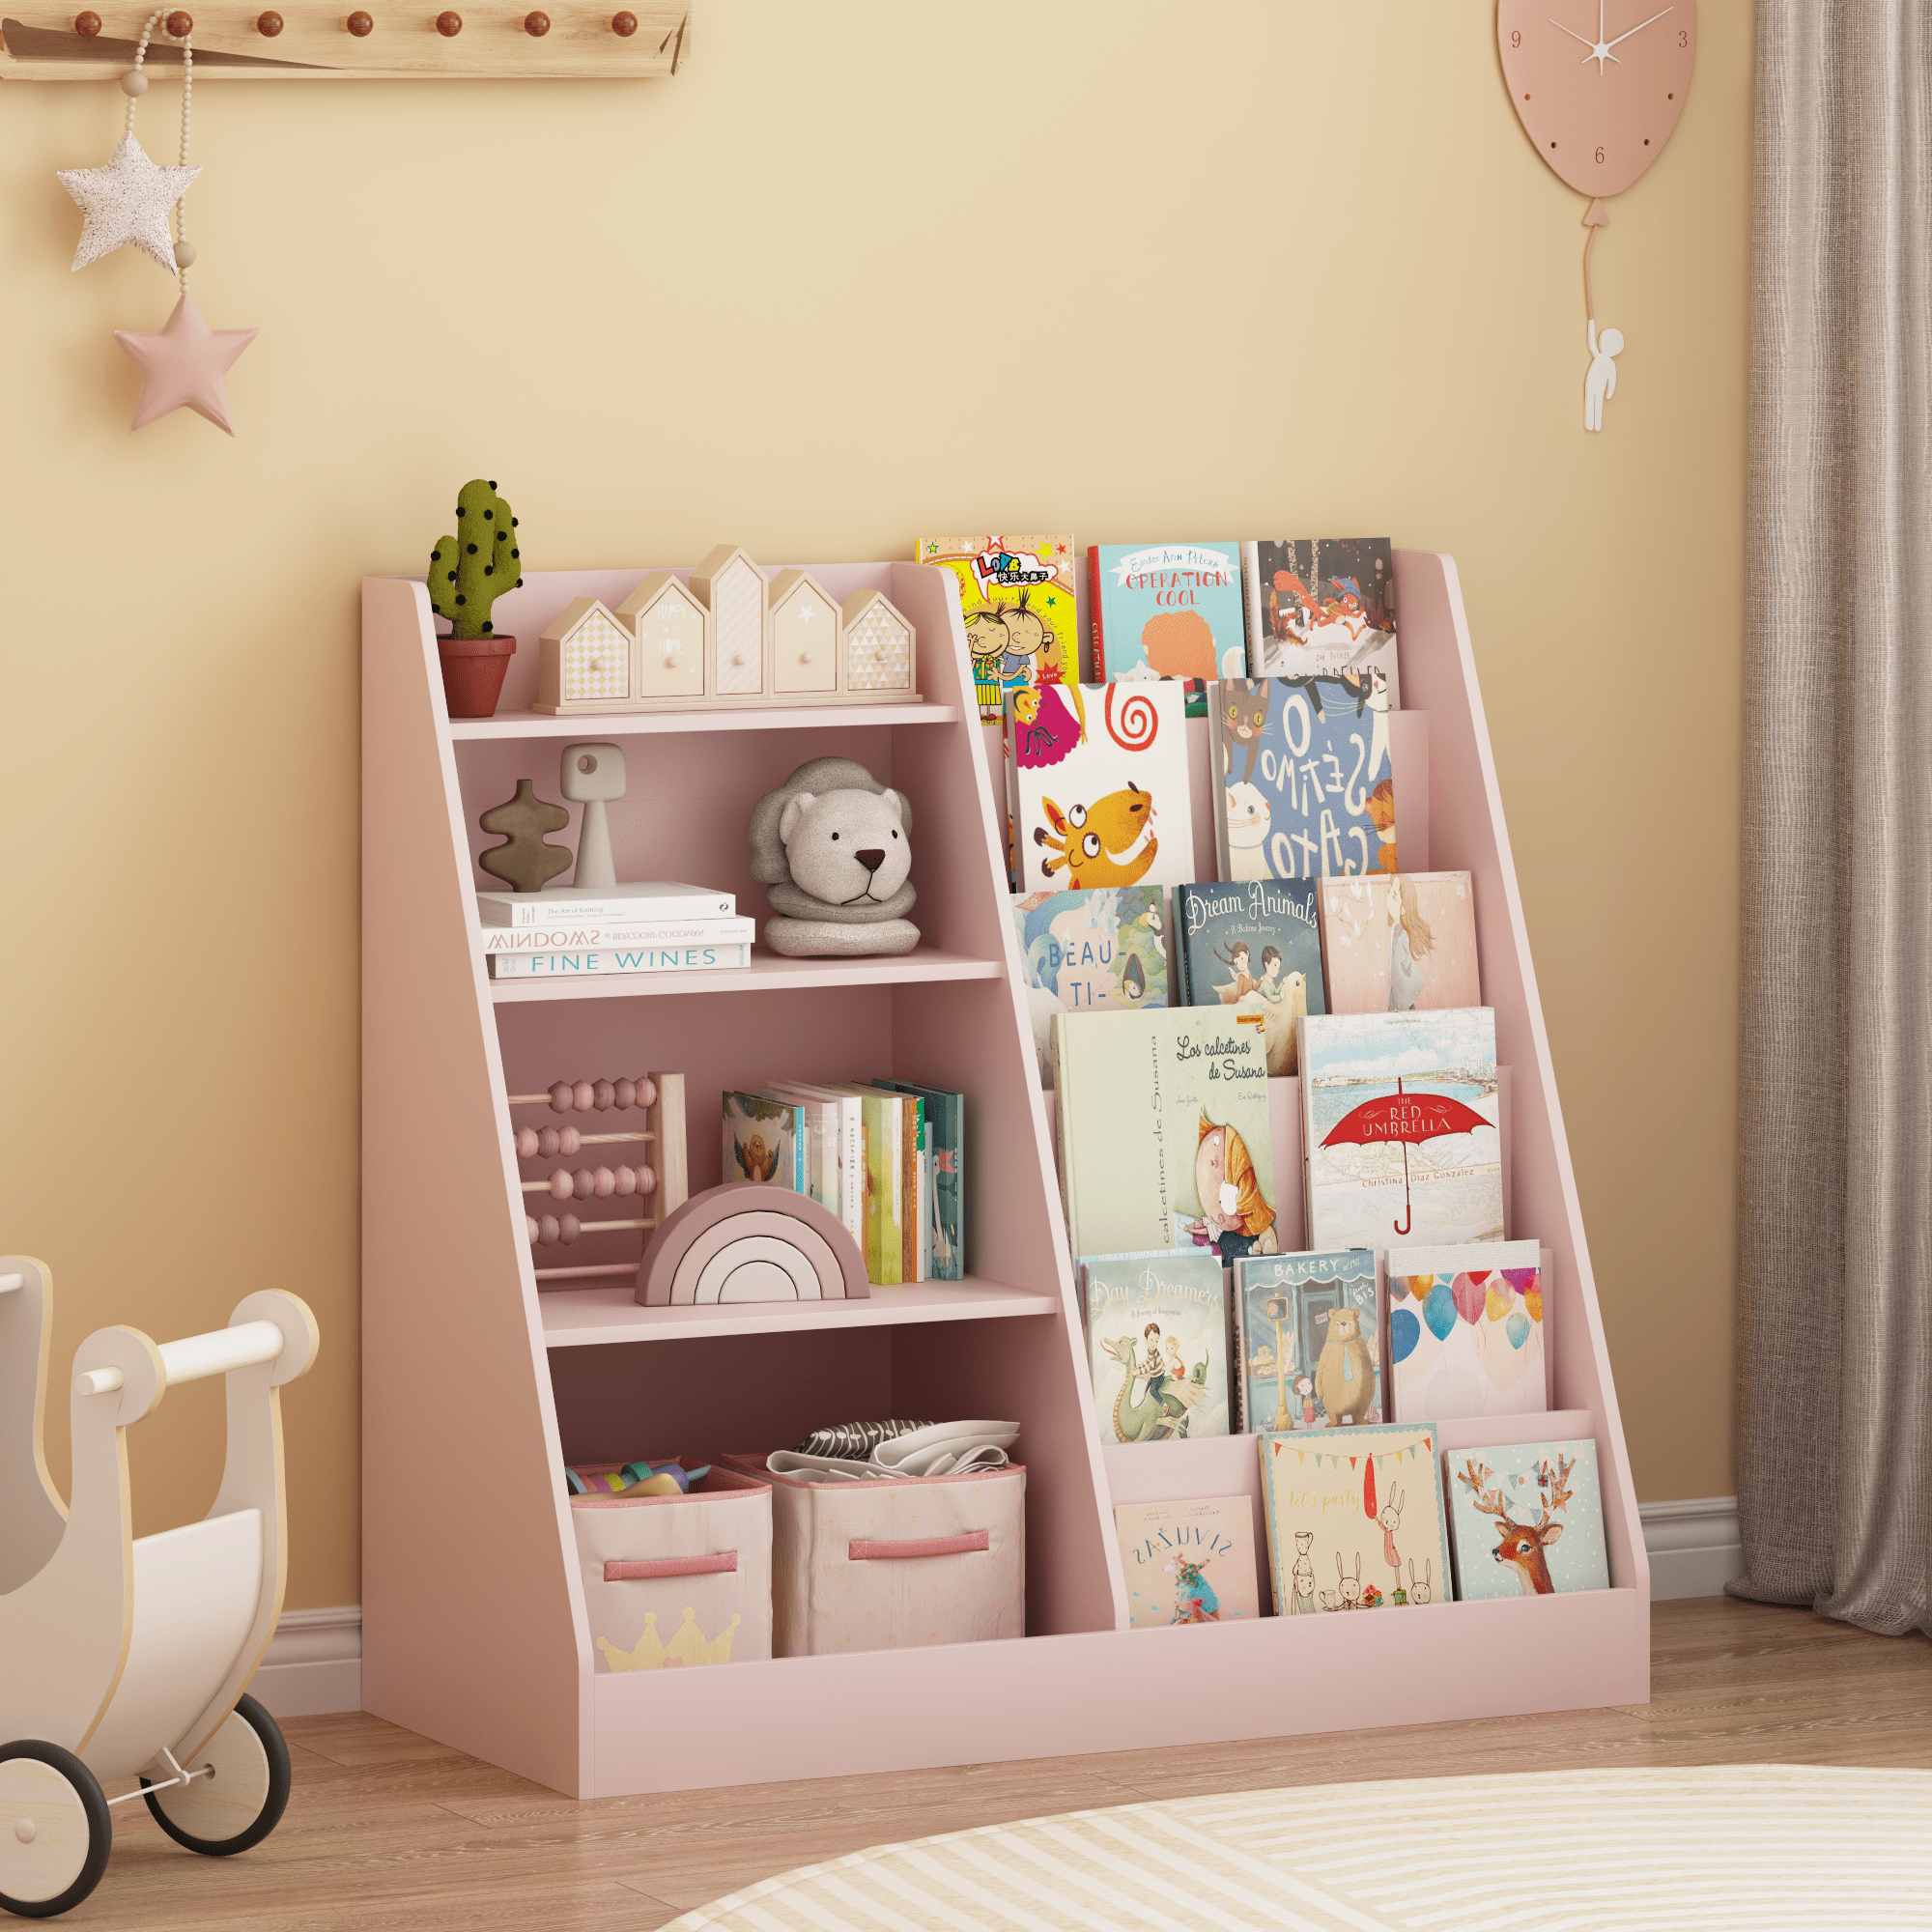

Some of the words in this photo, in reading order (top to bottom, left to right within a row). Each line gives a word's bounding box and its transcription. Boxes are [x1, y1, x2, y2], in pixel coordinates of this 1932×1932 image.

[1511, 30, 1521, 48] 9
[1678, 30, 1688, 48] 3
[1595, 146, 1605, 164] 6
[997, 571, 1049, 583] 快乐大鼻子
[1125, 571, 1228, 589] OPERATION
[1155, 589, 1200, 607] COOL
[657, 604, 687, 619] HAPPY
[1010, 596, 1043, 613] frend
[1057, 632, 1070, 659] friend
[659, 638, 683, 654] HOME
[1329, 651, 1352, 660] TUCKER
[1041, 671, 1058, 680] Love
[1185, 889, 1245, 936] Dream
[1247, 879, 1318, 928] Animals
[532, 953, 599, 972] FINE
[614, 949, 716, 968] WINES
[1049, 940, 1126, 968] BEAU-
[1070, 981, 1107, 1007] TI-
[1177, 1035, 1202, 1061] Los
[1204, 1036, 1251, 1057] calcetines
[1151, 1036, 1162, 1113] Susana
[1208, 1061, 1220, 1080] de
[1223, 1059, 1265, 1080] Susana
[1397, 1096, 1412, 1106] THE
[1390, 1105, 1421, 1121] RED
[1152, 1119, 1162, 1143] de
[1362, 1117, 1451, 1137] UMBRELLA
[1362, 1177, 1403, 1188] Christina
[1158, 1148, 1170, 1244] calcetines
[1274, 1259, 1339, 1277] BAKERY
[1089, 1275, 1129, 1317] Day
[1137, 1265, 1218, 1309] Dreamers
[1354, 1287, 1375, 1305] BIS
[1290, 1490, 1317, 1508] let's
[1321, 1489, 1361, 1515] party
